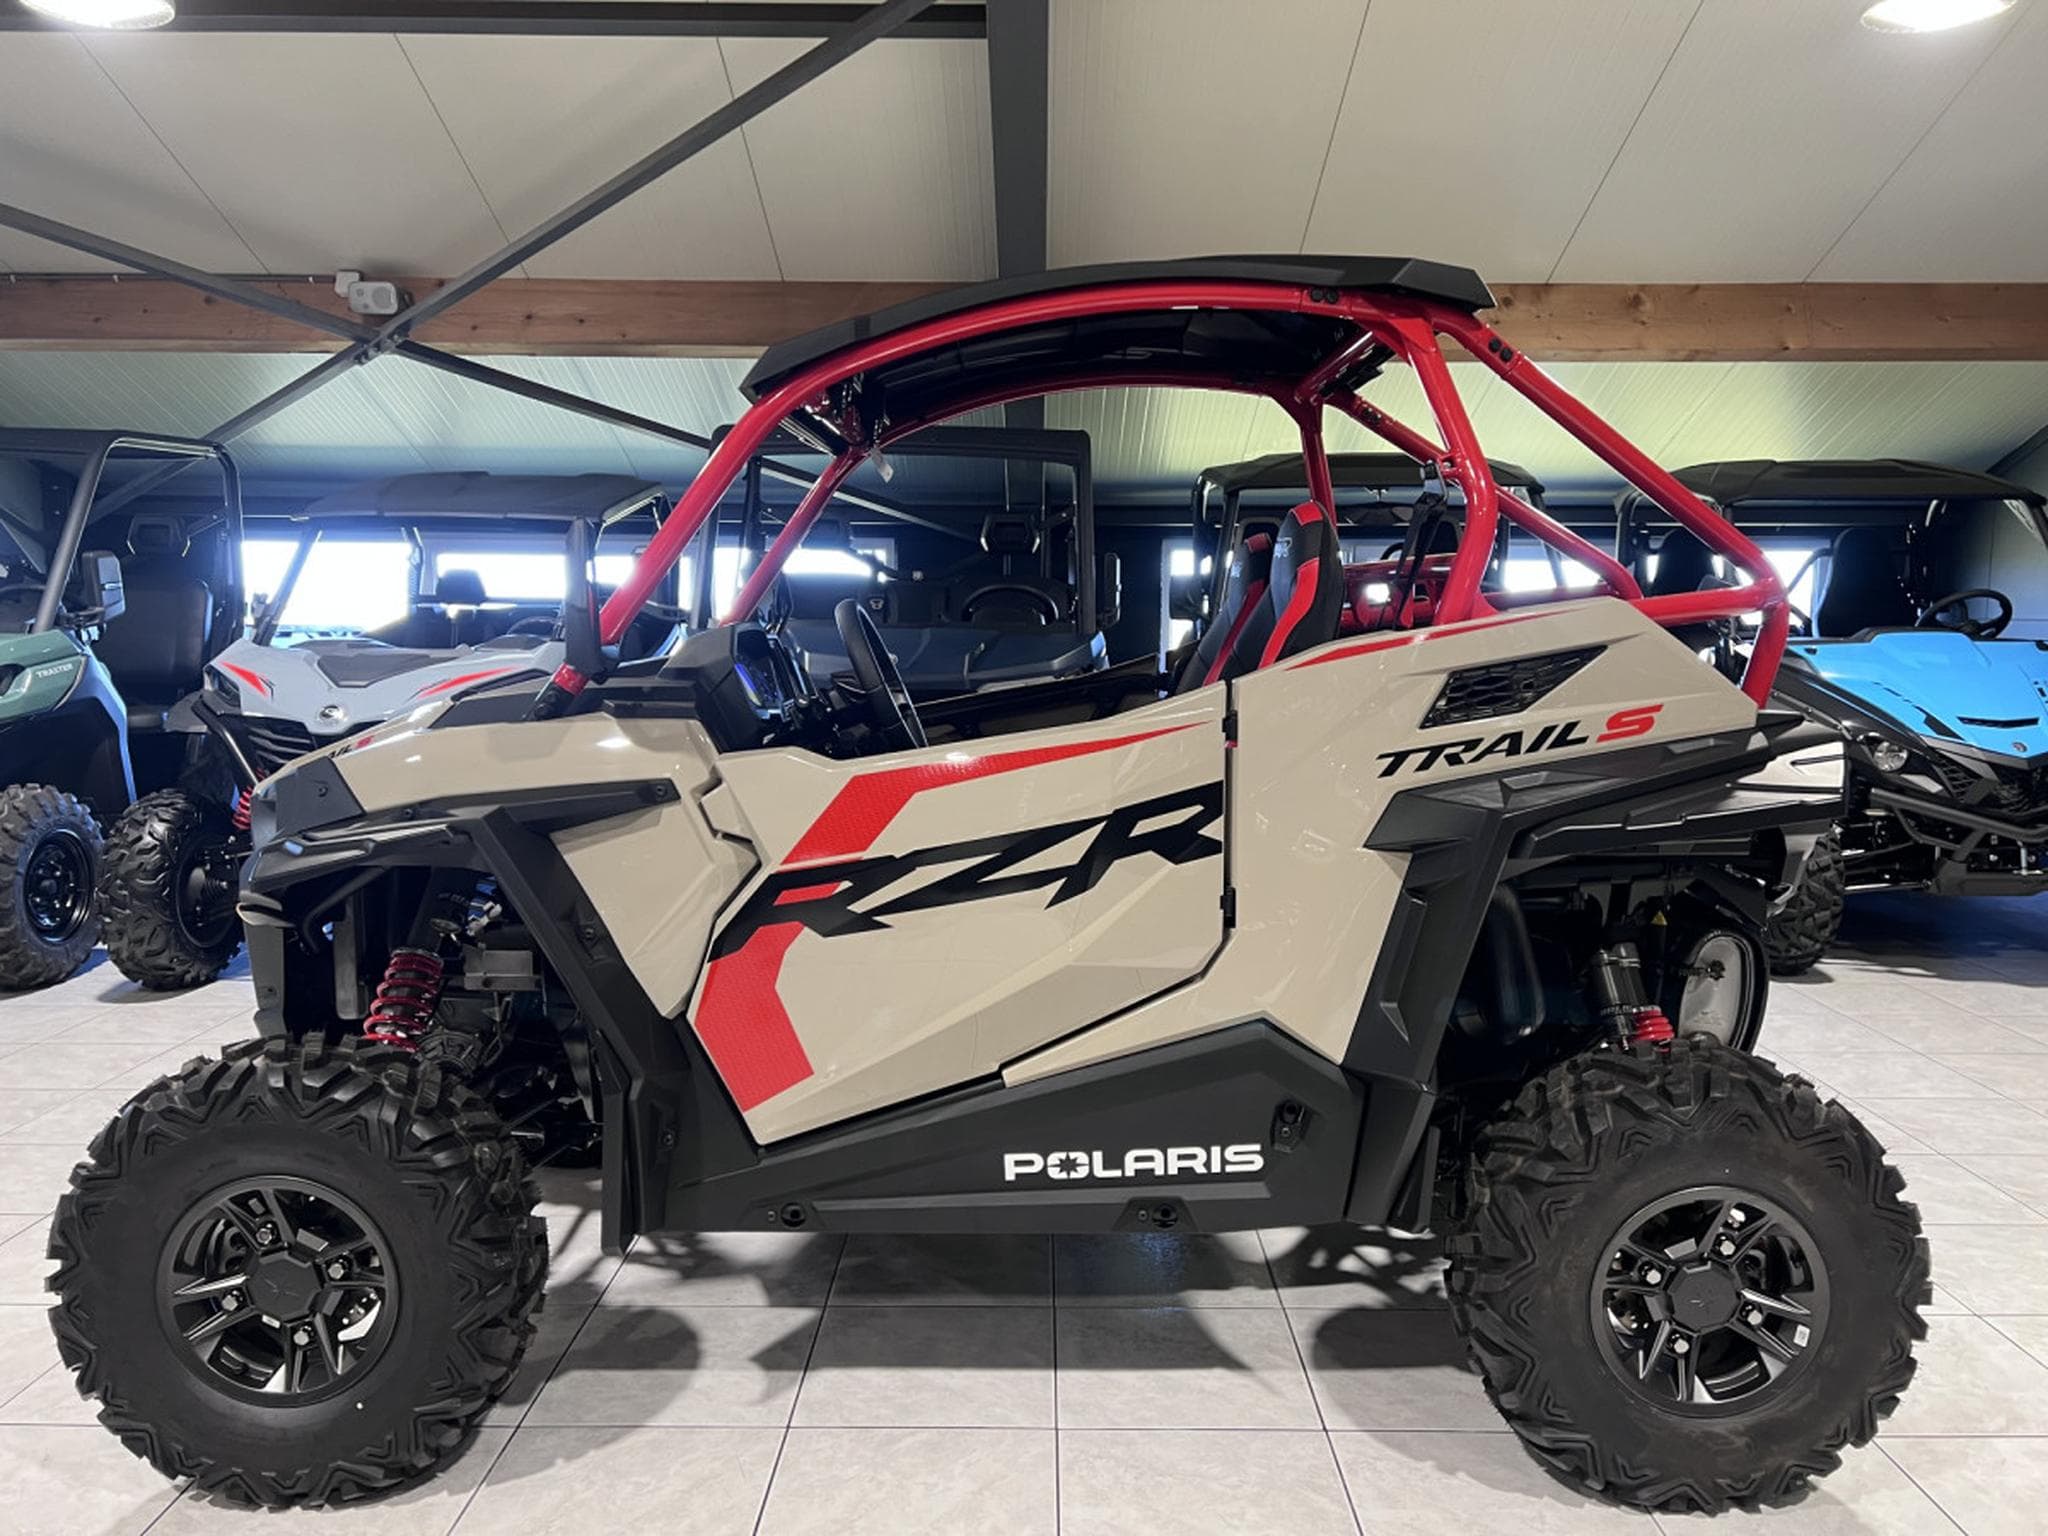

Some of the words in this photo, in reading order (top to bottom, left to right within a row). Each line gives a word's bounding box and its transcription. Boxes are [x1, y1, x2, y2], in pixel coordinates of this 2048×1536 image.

[36, 663, 74, 678] TRAXTER
[1376, 720, 1589, 779] TRAIL
[1595, 703, 1664, 743] S
[707, 779, 1224, 962] RZR
[1003, 1144, 1265, 1181] POLARIS
